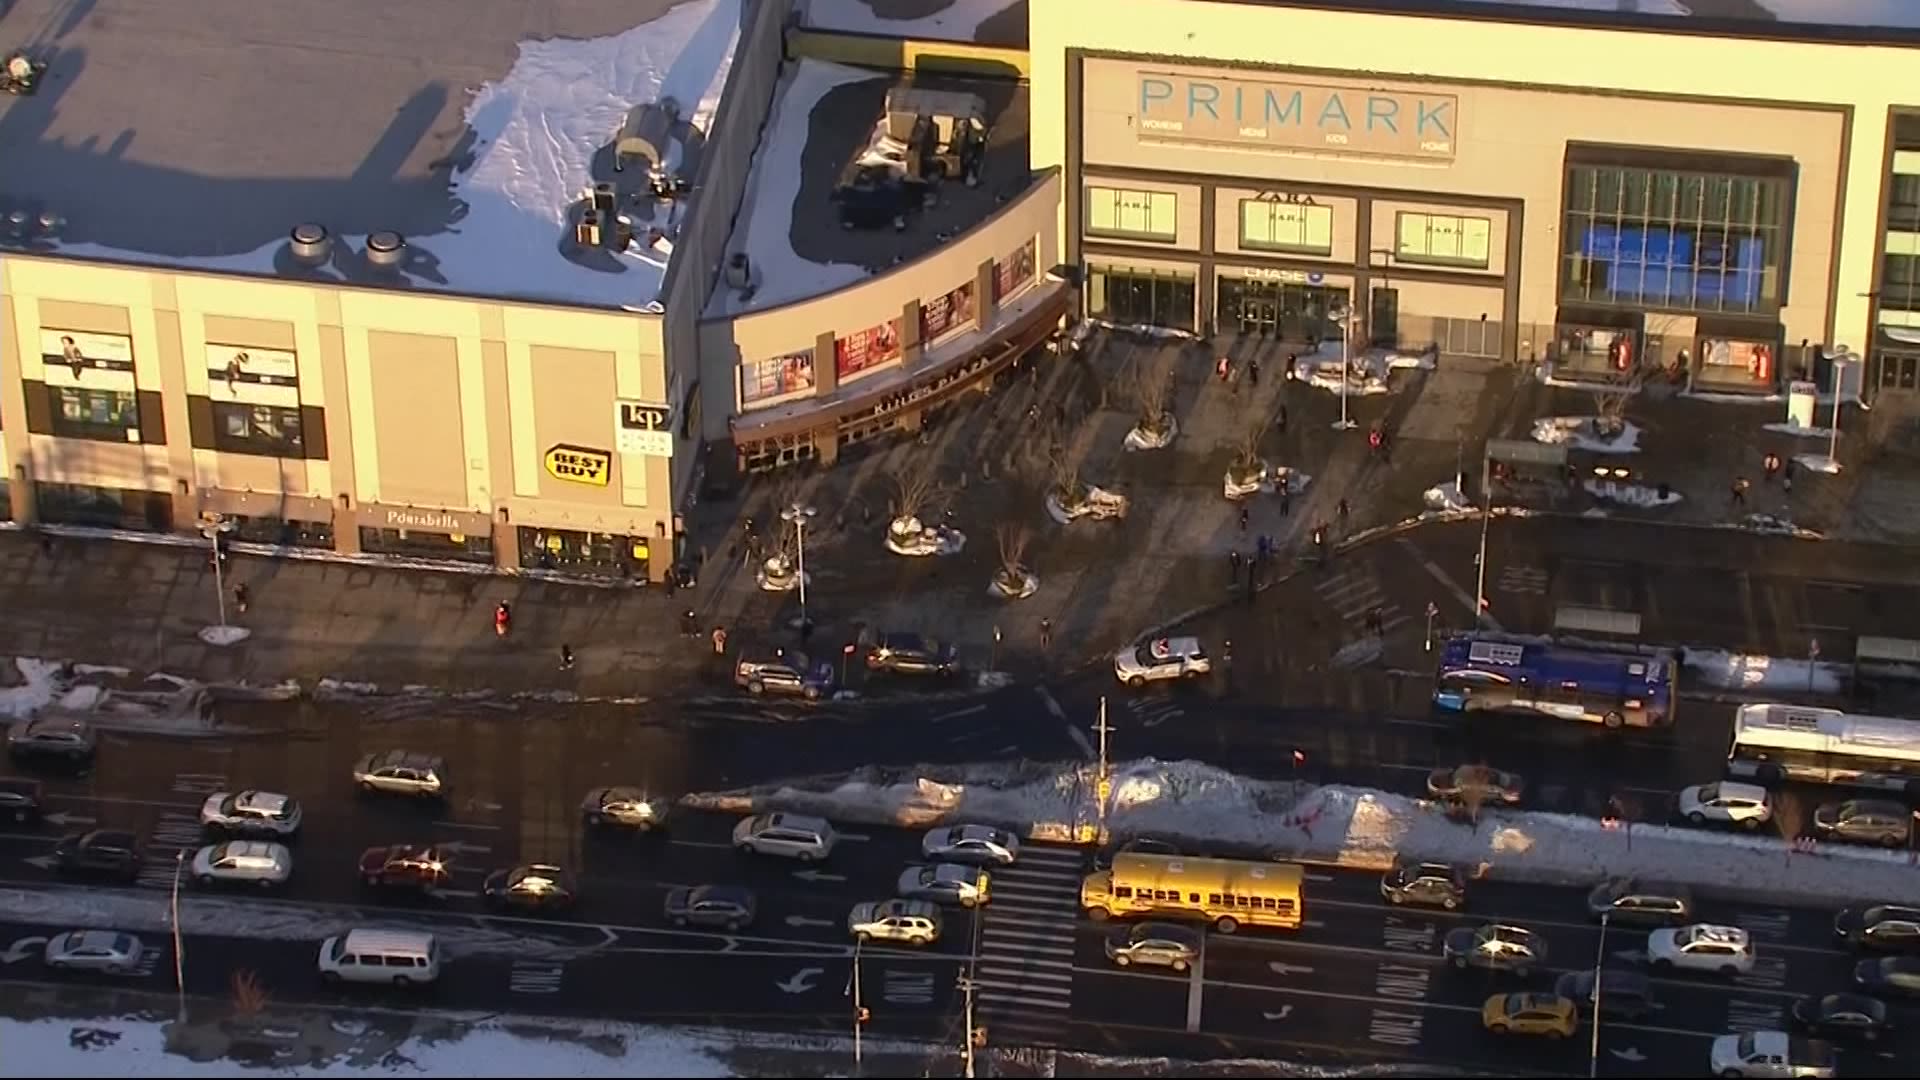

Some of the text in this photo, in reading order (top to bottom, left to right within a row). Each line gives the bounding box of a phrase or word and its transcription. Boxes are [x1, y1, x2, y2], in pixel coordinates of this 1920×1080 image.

[1141, 79, 1450, 138] PRIMARK
[1141, 119, 1183, 131] WOMENS
[1420, 141, 1450, 152] HOME
[1255, 190, 1317, 207] ZARA
[1243, 267, 1305, 282] CHASE
[554, 452, 605, 469] BEST
[556, 463, 600, 479] BUY
